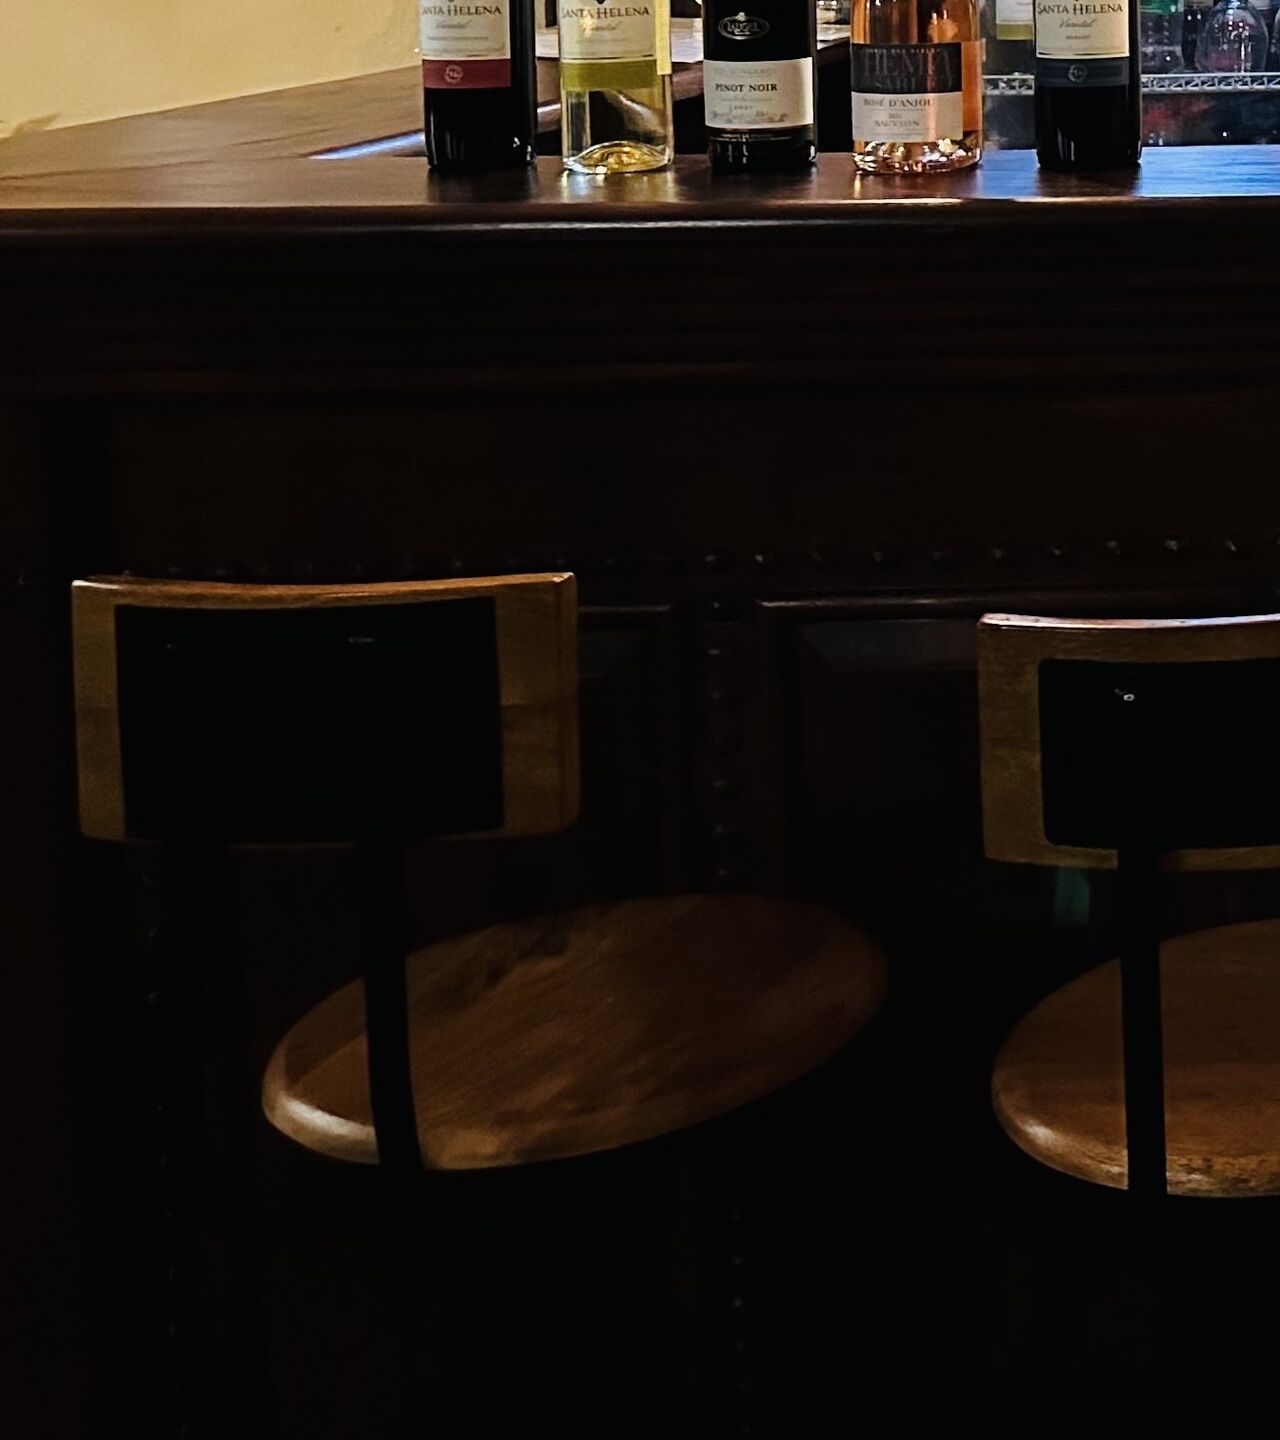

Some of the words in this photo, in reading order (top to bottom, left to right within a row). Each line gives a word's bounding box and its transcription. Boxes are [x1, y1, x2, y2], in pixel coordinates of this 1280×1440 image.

[447, 4, 503, 16] HELENA
[561, 7, 594, 19] SANTA
[597, 6, 650, 19] HELENA
[1037, 3, 1069, 15] SANTA
[1073, 3, 1123, 15] HELENA
[715, 83, 745, 92] PINOT
[748, 83, 778, 92] NOIR
